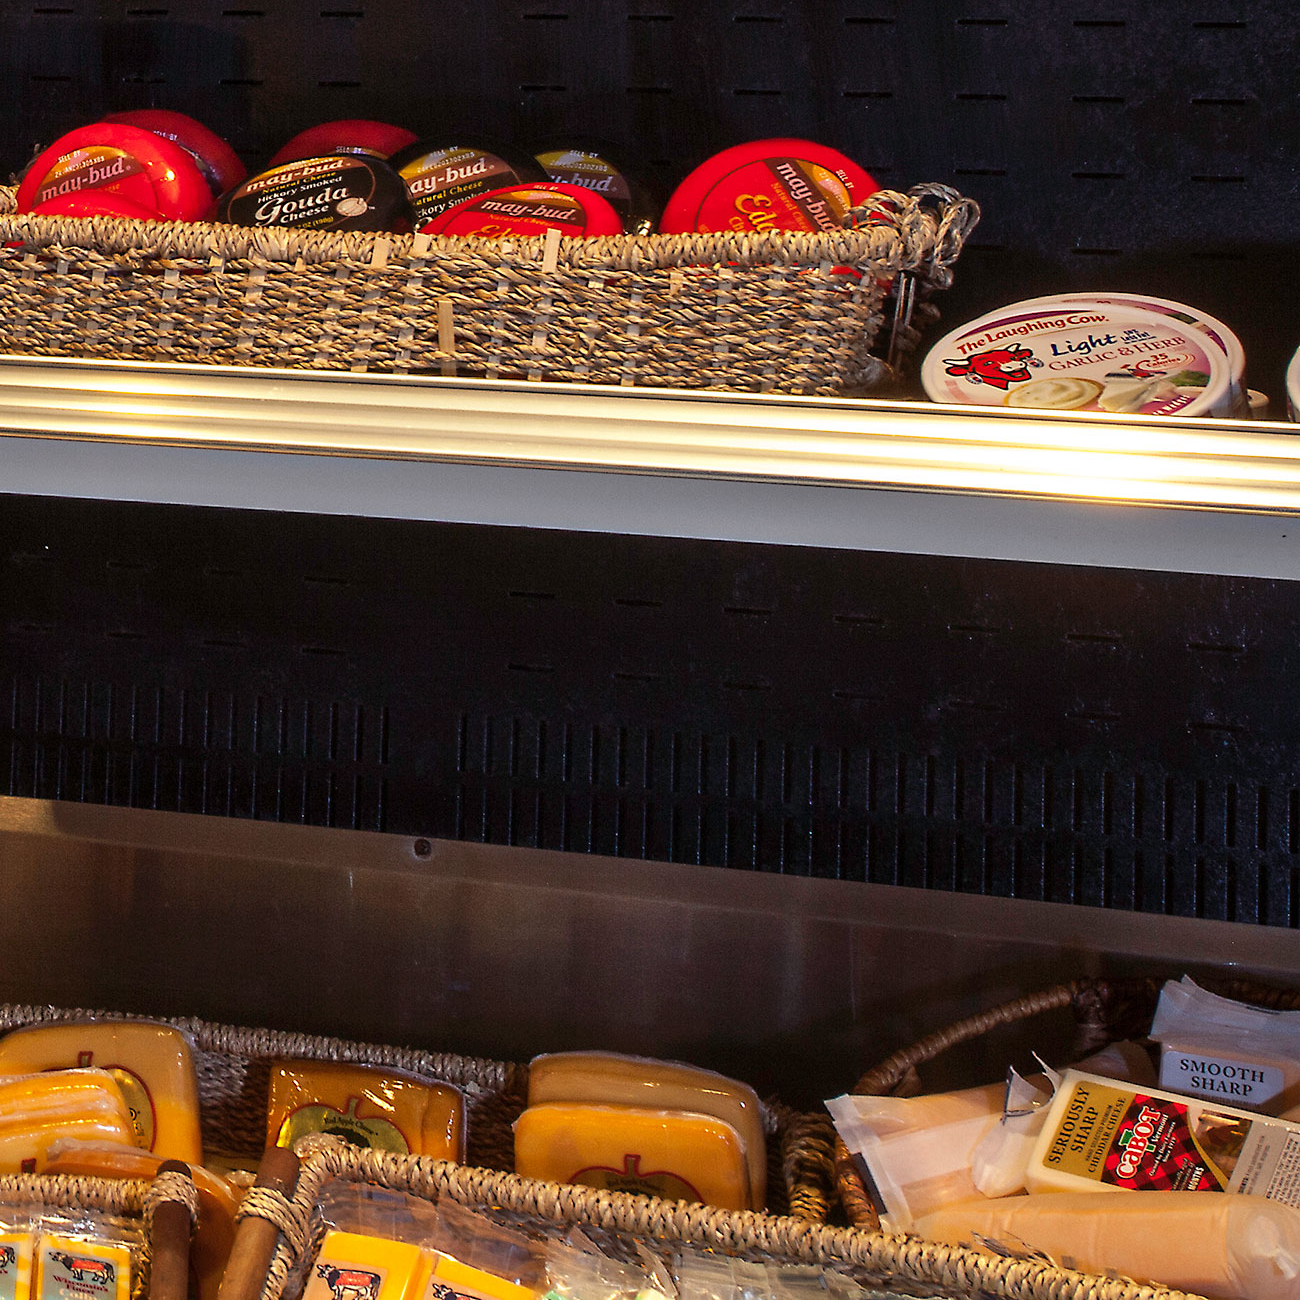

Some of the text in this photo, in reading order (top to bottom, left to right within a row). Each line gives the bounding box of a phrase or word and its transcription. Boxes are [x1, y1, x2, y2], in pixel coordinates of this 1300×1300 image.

[42, 157, 125, 202] may-bud
[246, 160, 344, 192] may-bud
[258, 176, 342, 203] Hickory Smoked
[262, 171, 336, 195] Natural Cheese
[410, 158, 487, 194] ay-bud
[449, 181, 483, 195] Cheese
[255, 187, 350, 226] Gouda
[481, 200, 576, 220] may-bud
[771, 182, 797, 211] Natural
[488, 214, 522, 223] Natural
[957, 314, 1105, 355] The Laughing Cow
[1050, 334, 1118, 357] Light
[1049, 336, 1186, 371] GARLIC & HERB
[1151, 353, 1169, 363] 35
[1180, 1058, 1265, 1083] SMOOTH
[1191, 1075, 1253, 1097] SHARP
[1048, 1087, 1090, 1164] SERIOUSLY
[1070, 1106, 1099, 1153] SHARP
[1088, 1096, 1128, 1173] CHEDDAR CHEESE
[1151, 1113, 1169, 1142] Vermont
[53, 1275, 109, 1292] Wisconsin's
[65, 1283, 94, 1294] Finest
